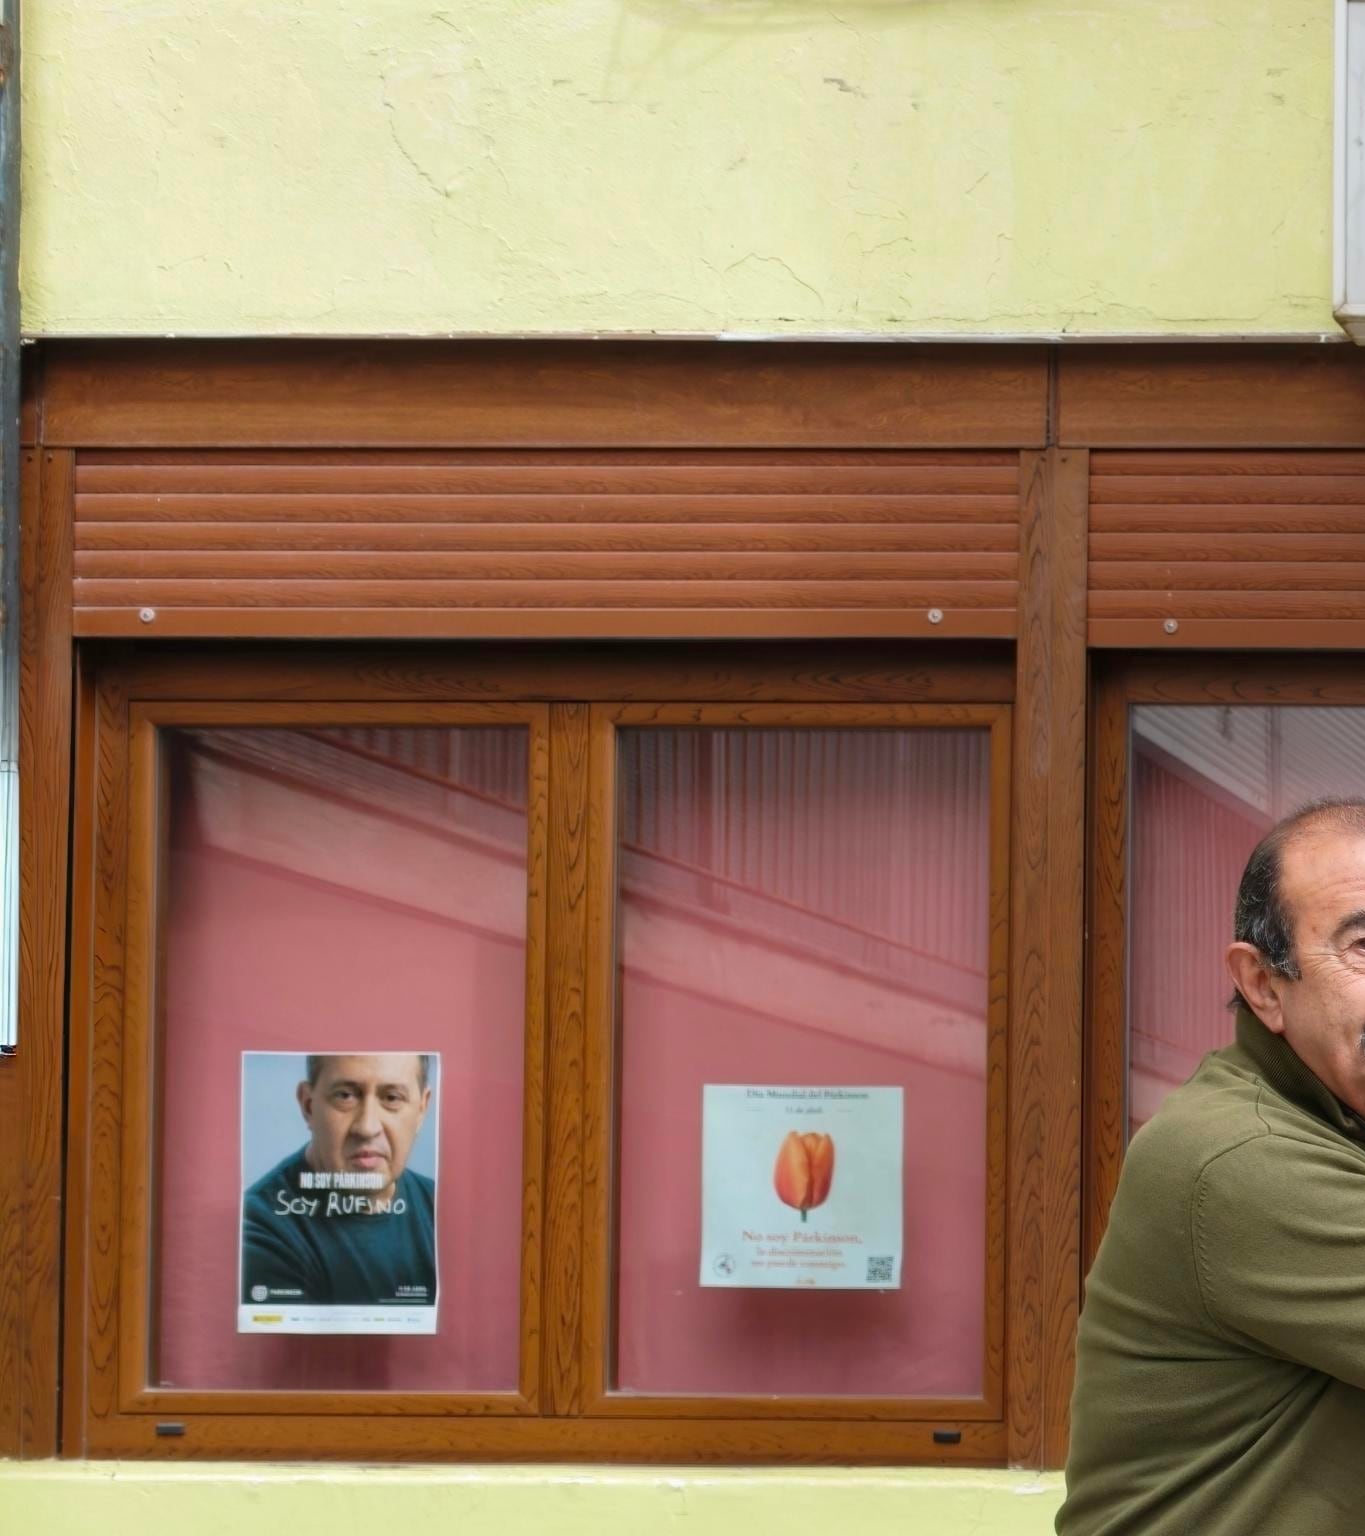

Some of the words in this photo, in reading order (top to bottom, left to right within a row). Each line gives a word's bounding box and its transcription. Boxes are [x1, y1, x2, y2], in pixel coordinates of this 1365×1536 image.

[300, 1172, 313, 1189] NO
[315, 1173, 331, 1189] SOY
[326, 1191, 406, 1217] RUFINO
